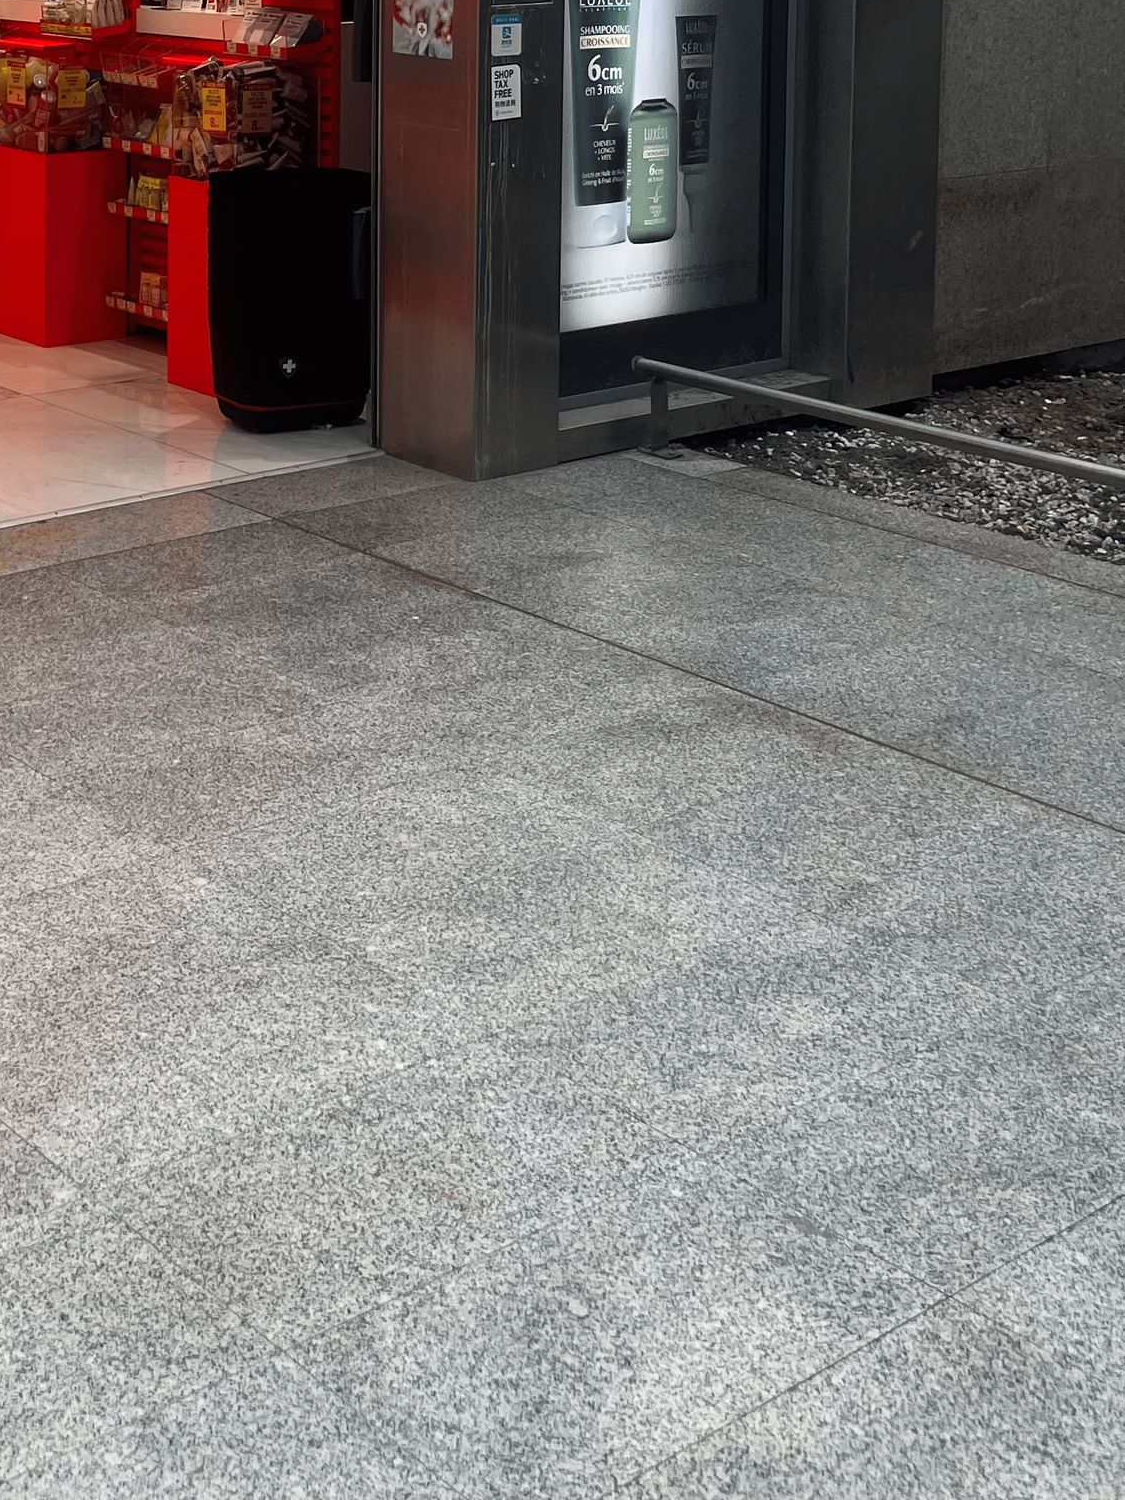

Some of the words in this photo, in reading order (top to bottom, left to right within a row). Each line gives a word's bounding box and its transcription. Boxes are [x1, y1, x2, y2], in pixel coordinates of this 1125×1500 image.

[580, 24, 631, 36] SHAMPOOING
[580, 36, 629, 49] CROISSANCE
[587, 53, 623, 82] 6cm
[494, 69, 514, 80] SHOP
[494, 79, 509, 90] TAX
[585, 85, 596, 97] en
[596, 83, 603, 96] 3
[494, 88, 513, 99] FREE
[648, 163, 665, 176] 6cm
